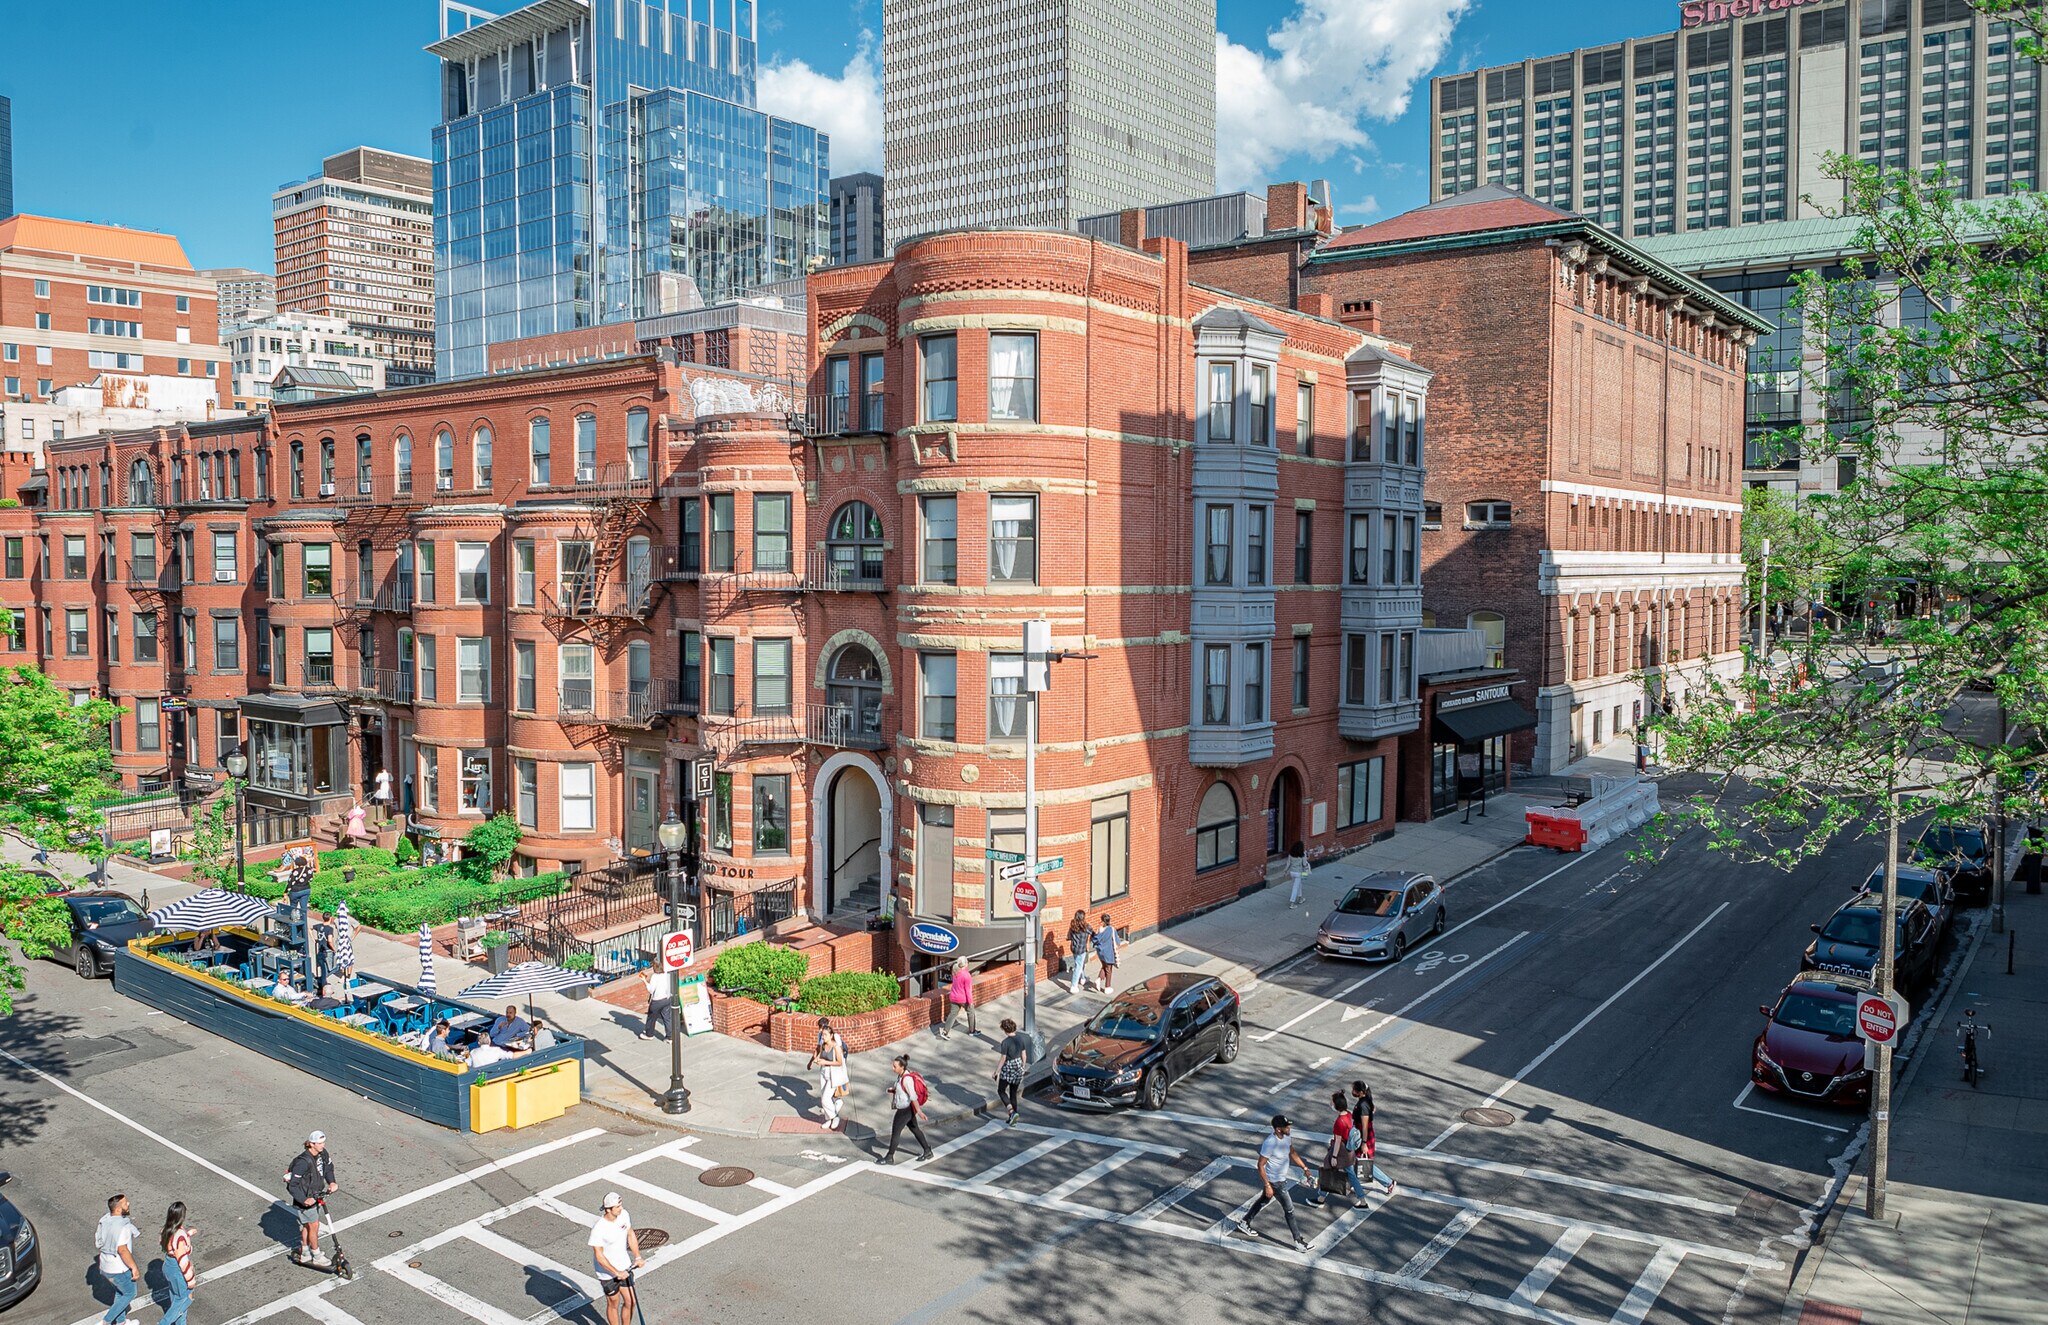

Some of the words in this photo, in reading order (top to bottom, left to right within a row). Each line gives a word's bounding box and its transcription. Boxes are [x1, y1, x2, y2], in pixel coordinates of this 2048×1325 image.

[1476, 686, 1509, 701] SANTOUKA
[702, 767, 708, 776] G
[702, 779, 709, 788] T
[993, 850, 1018, 862] NEWBURY
[720, 866, 754, 878] TOUR
[1025, 888, 1035, 896] NOT
[1018, 899, 1033, 907] ENTER
[913, 926, 952, 943] Dependable
[677, 939, 688, 947] NOT
[1864, 1005, 1874, 1013] DO
[1877, 1009, 1891, 1019] NOT
[1866, 1022, 1888, 1034] ENTER
